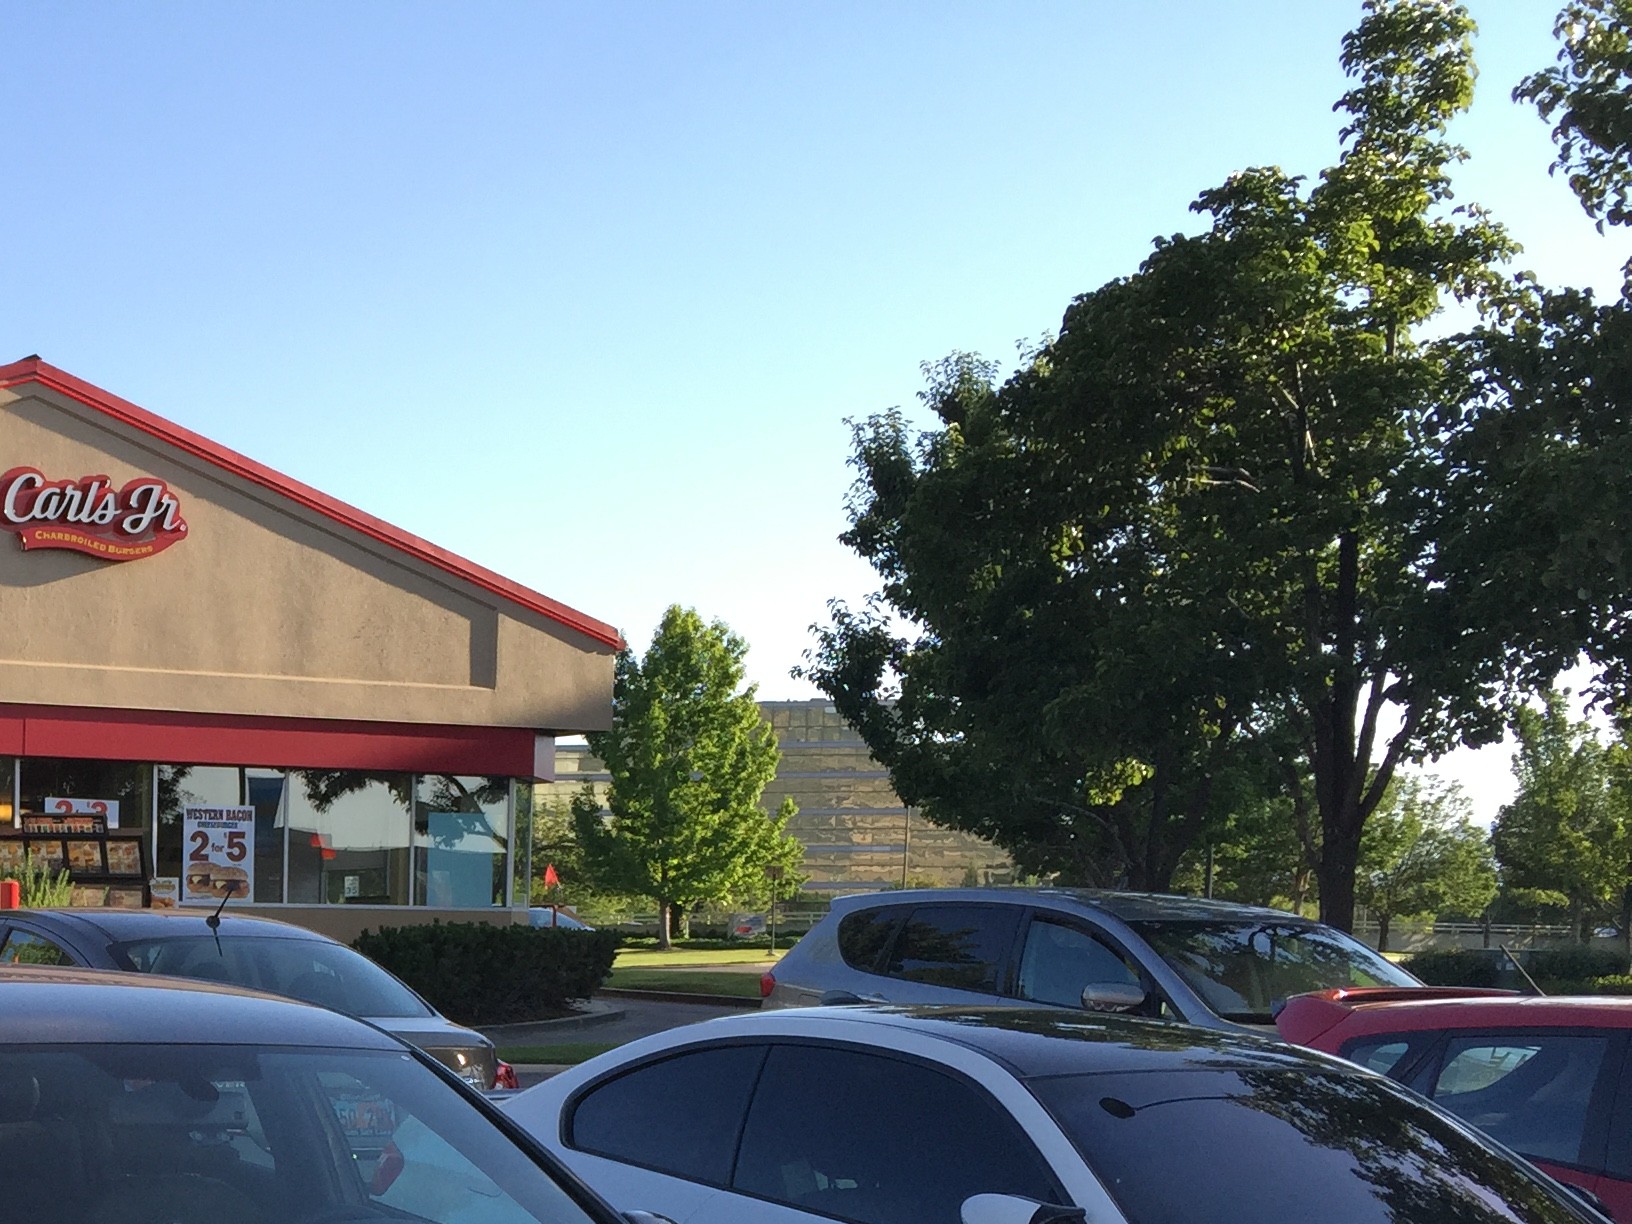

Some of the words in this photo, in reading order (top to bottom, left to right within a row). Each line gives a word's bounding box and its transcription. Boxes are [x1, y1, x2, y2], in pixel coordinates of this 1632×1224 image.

[3, 473, 123, 525] Carl's
[34, 530, 107, 551] CHARBROILED
[108, 545, 154, 555] BURGERS
[186, 809, 224, 820] WESTERN
[226, 809, 253, 822] BACON
[189, 831, 209, 861] 2
[211, 843, 224, 852] for
